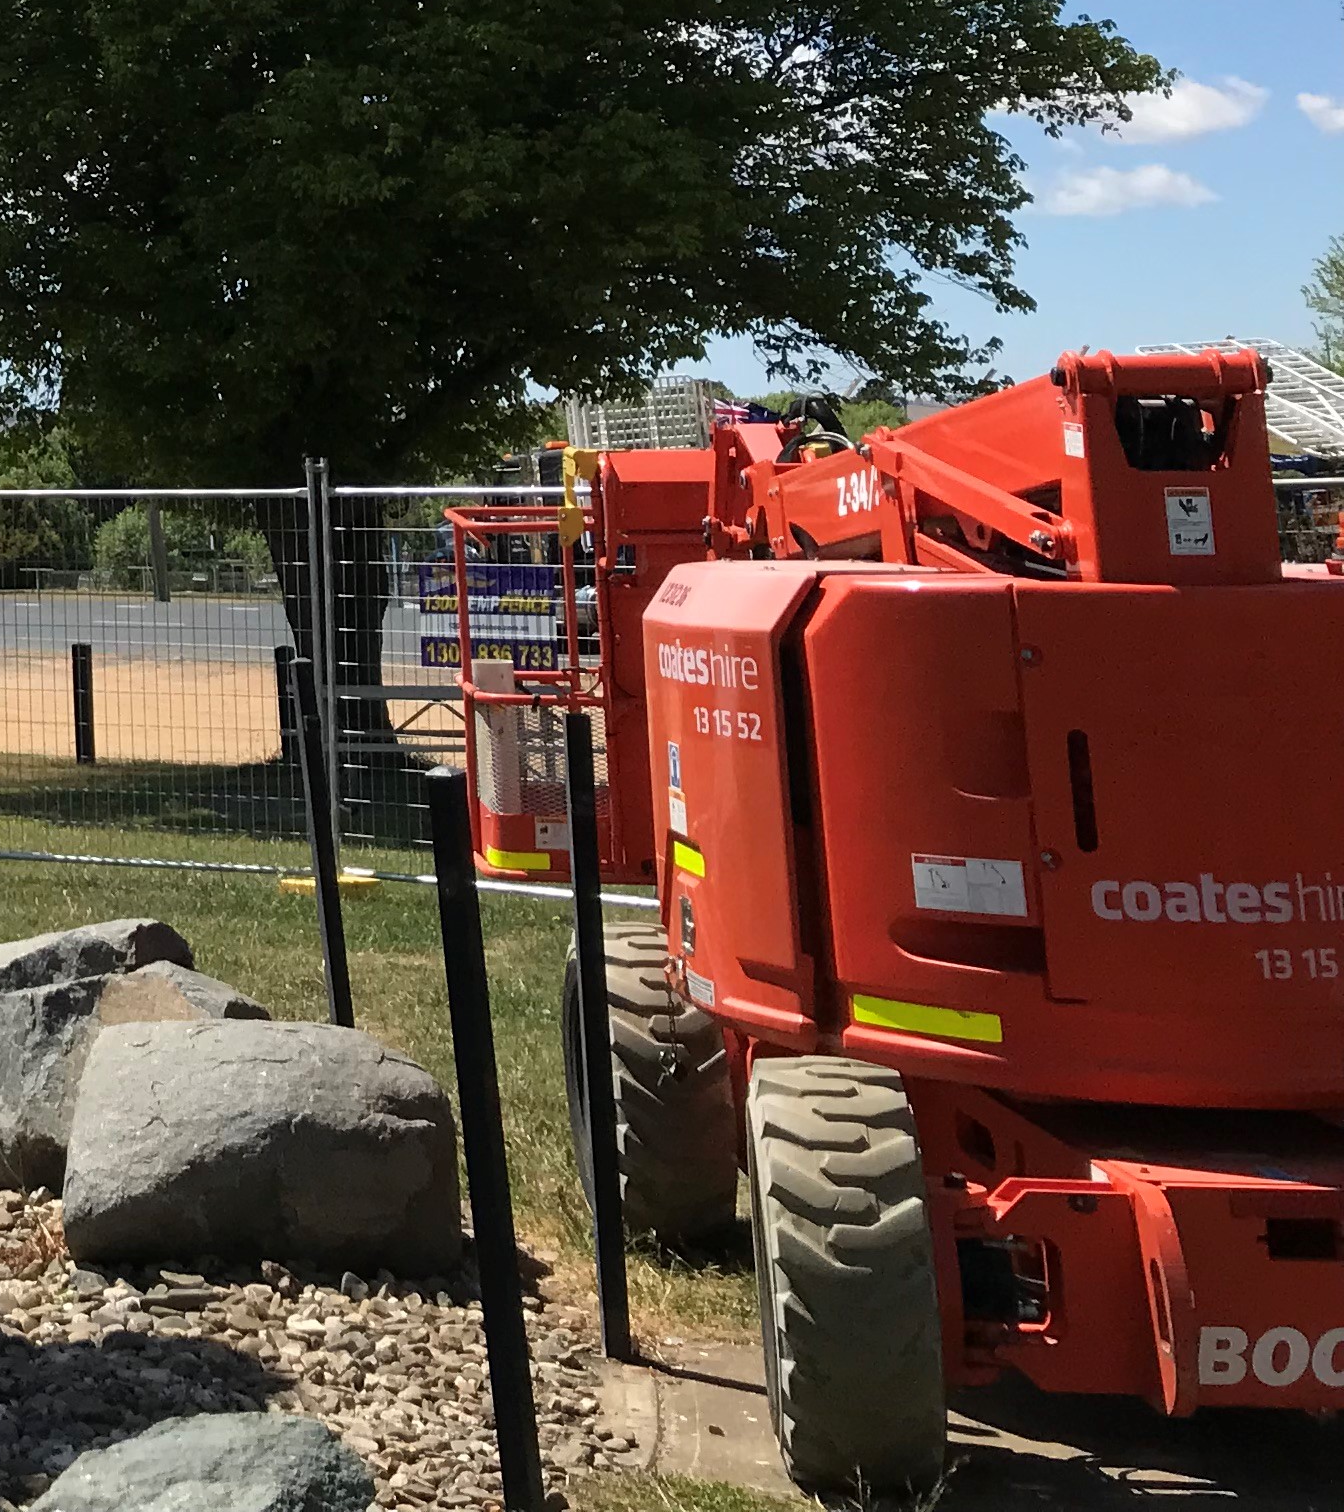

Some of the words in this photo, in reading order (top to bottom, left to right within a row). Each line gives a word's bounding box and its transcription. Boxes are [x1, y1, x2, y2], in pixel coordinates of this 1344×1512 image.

[423, 594, 552, 614] 1300EMPFENCE
[426, 642, 460, 664] 130
[518, 645, 553, 668] 733
[694, 706, 710, 734] 13
[713, 709, 732, 738] 15
[737, 712, 762, 741] 52
[1255, 948, 1293, 980] 13
[1302, 948, 1339, 979] 15
